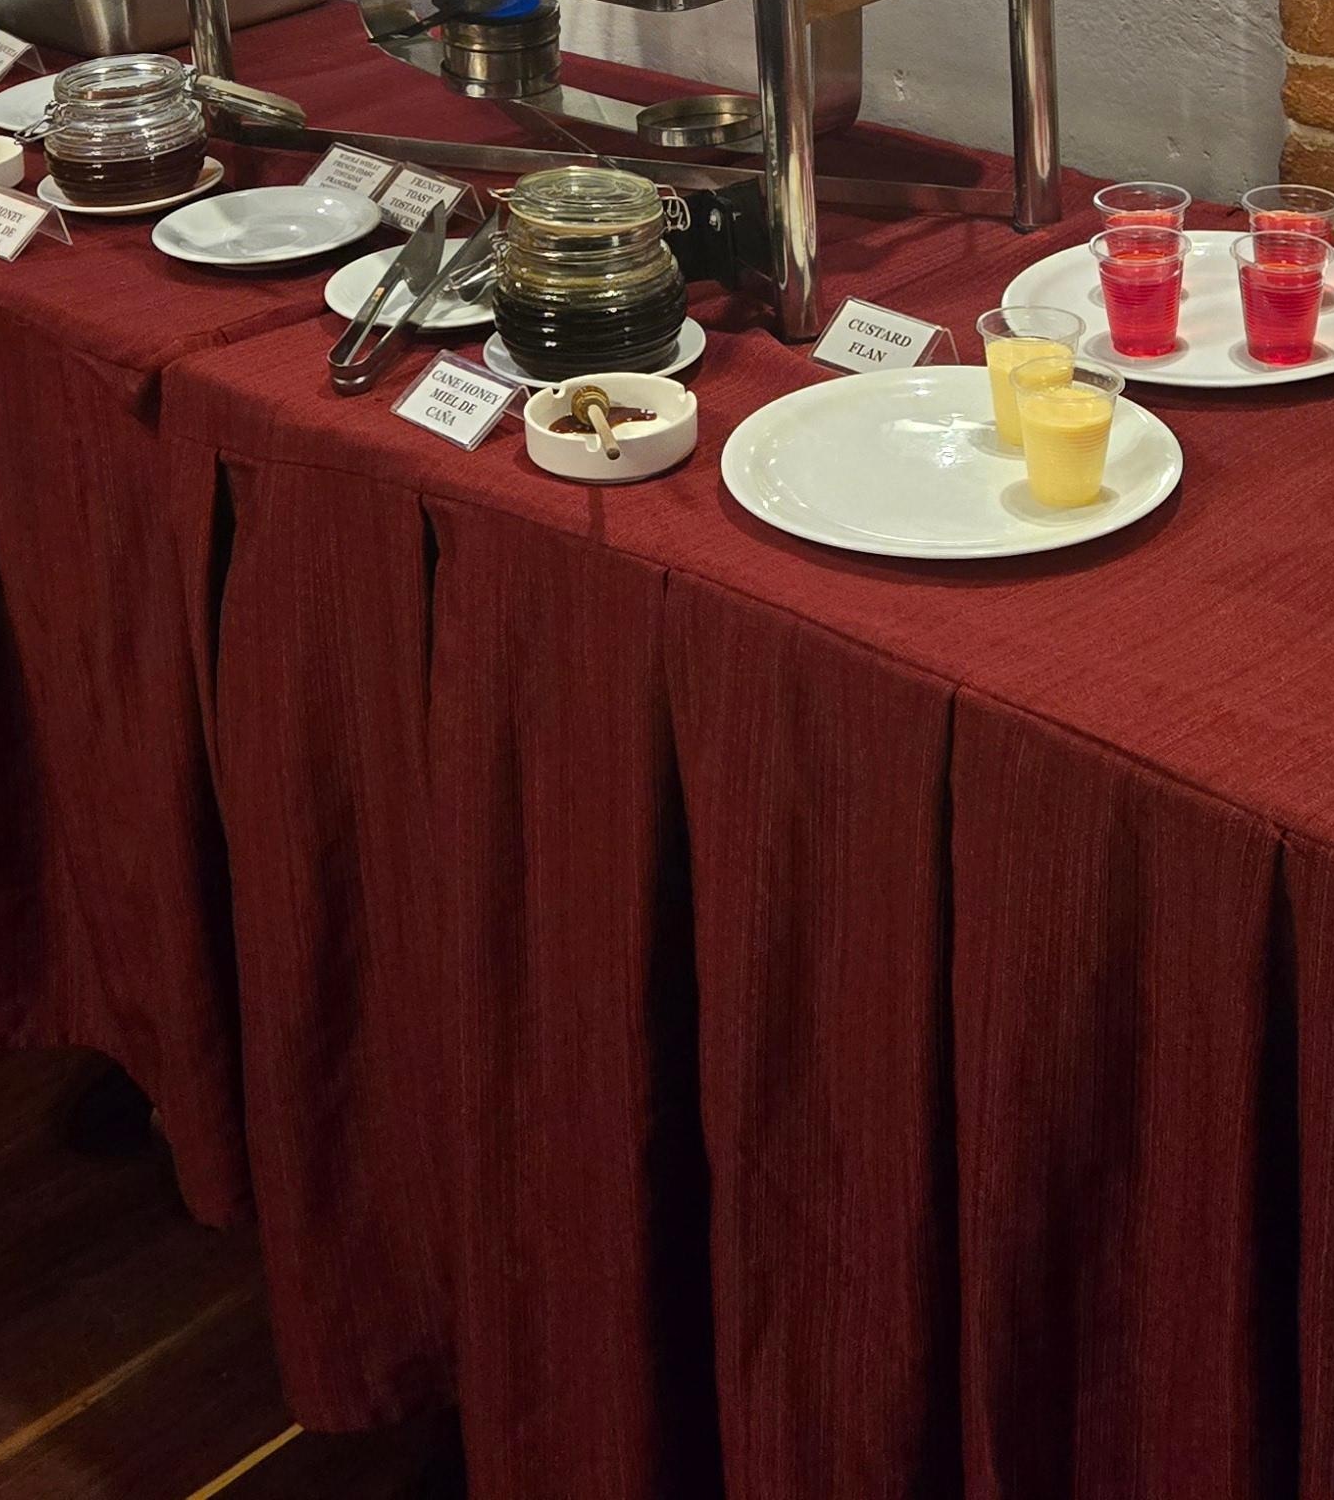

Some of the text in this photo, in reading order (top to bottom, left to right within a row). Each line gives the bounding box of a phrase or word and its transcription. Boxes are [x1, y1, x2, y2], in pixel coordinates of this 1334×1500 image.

[410, 176, 445, 195] FRENCH
[405, 188, 434, 204] TOAST
[0, 226, 17, 238] DE
[848, 318, 912, 347] CUSTARD
[848, 341, 888, 362] FLAN
[432, 370, 502, 405] CANE HONEY
[430, 388, 478, 415] MIEL DE
[425, 406, 457, 426] CAÑA
